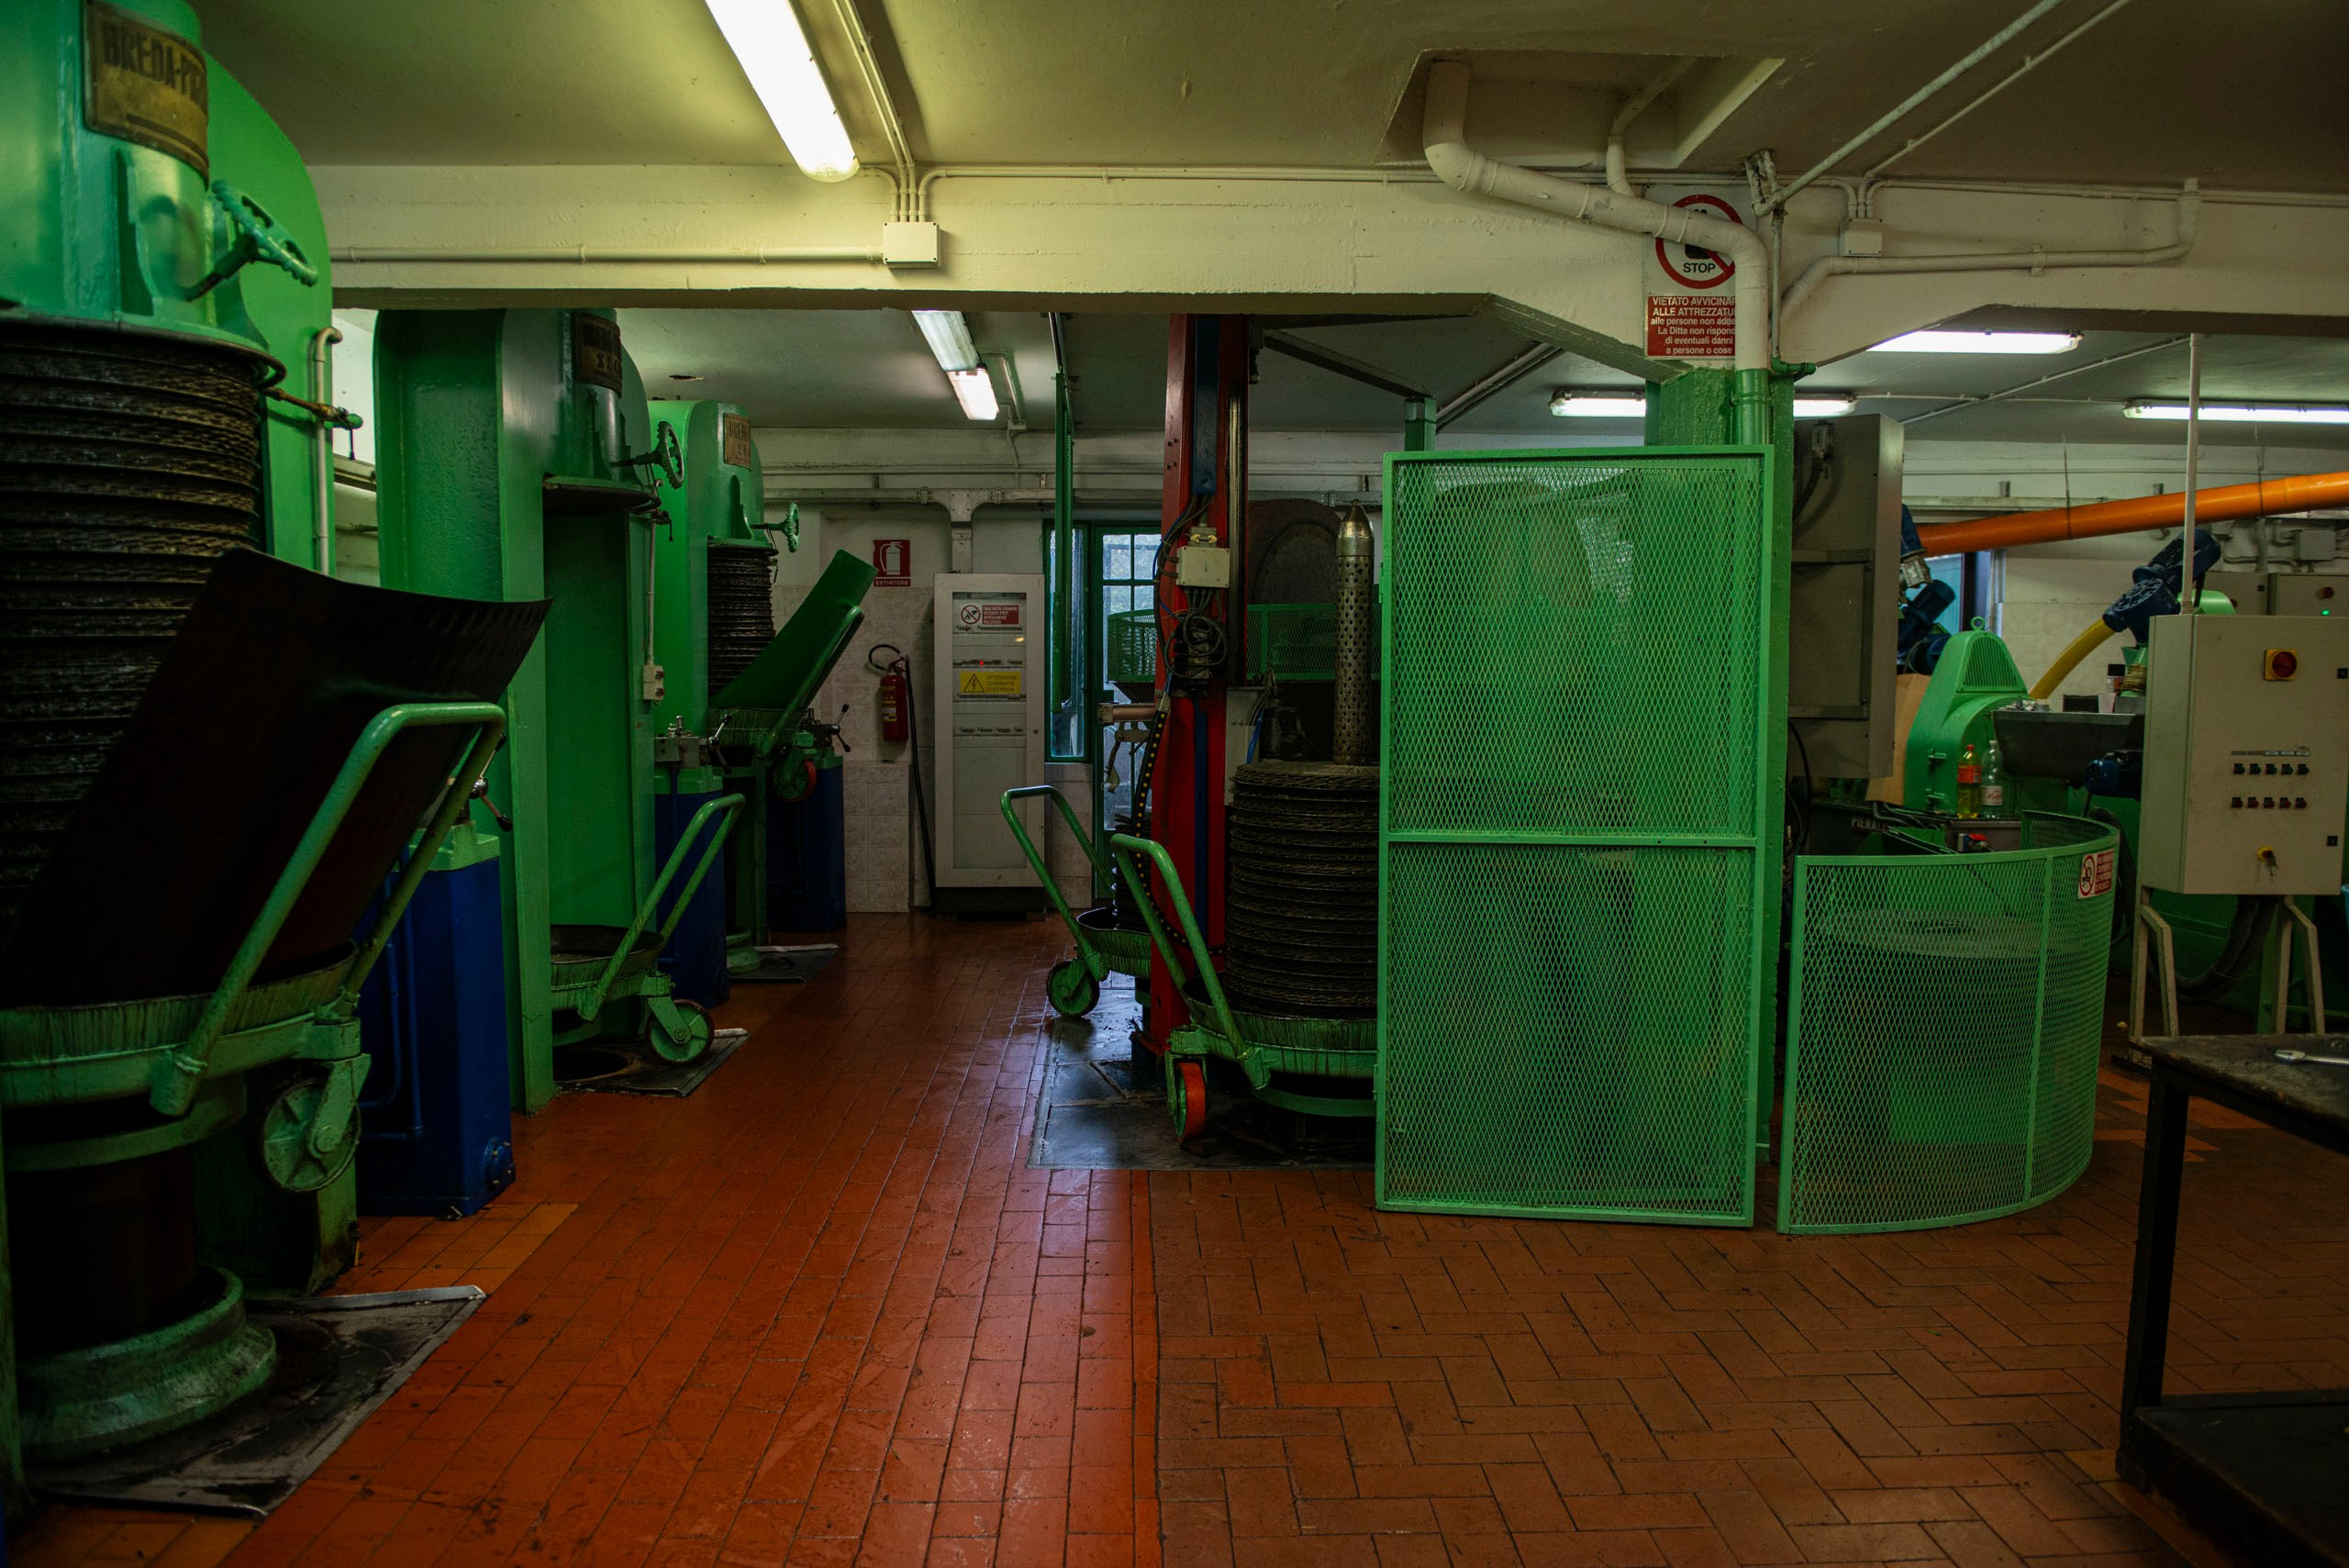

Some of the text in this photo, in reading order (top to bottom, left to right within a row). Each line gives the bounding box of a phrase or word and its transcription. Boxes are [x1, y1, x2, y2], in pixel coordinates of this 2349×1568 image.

[1683, 262, 1715, 273] STOP
[1653, 296, 1689, 306] VIETATO
[1653, 307, 1676, 317] ALLE
[1651, 317, 1664, 325] alle
[1666, 318, 1698, 327] persone
[1658, 327, 1667, 335] La
[1669, 327, 1688, 335] Ditta
[1664, 336, 1733, 344] di eventuali danni
[1673, 348, 1705, 356] persone
